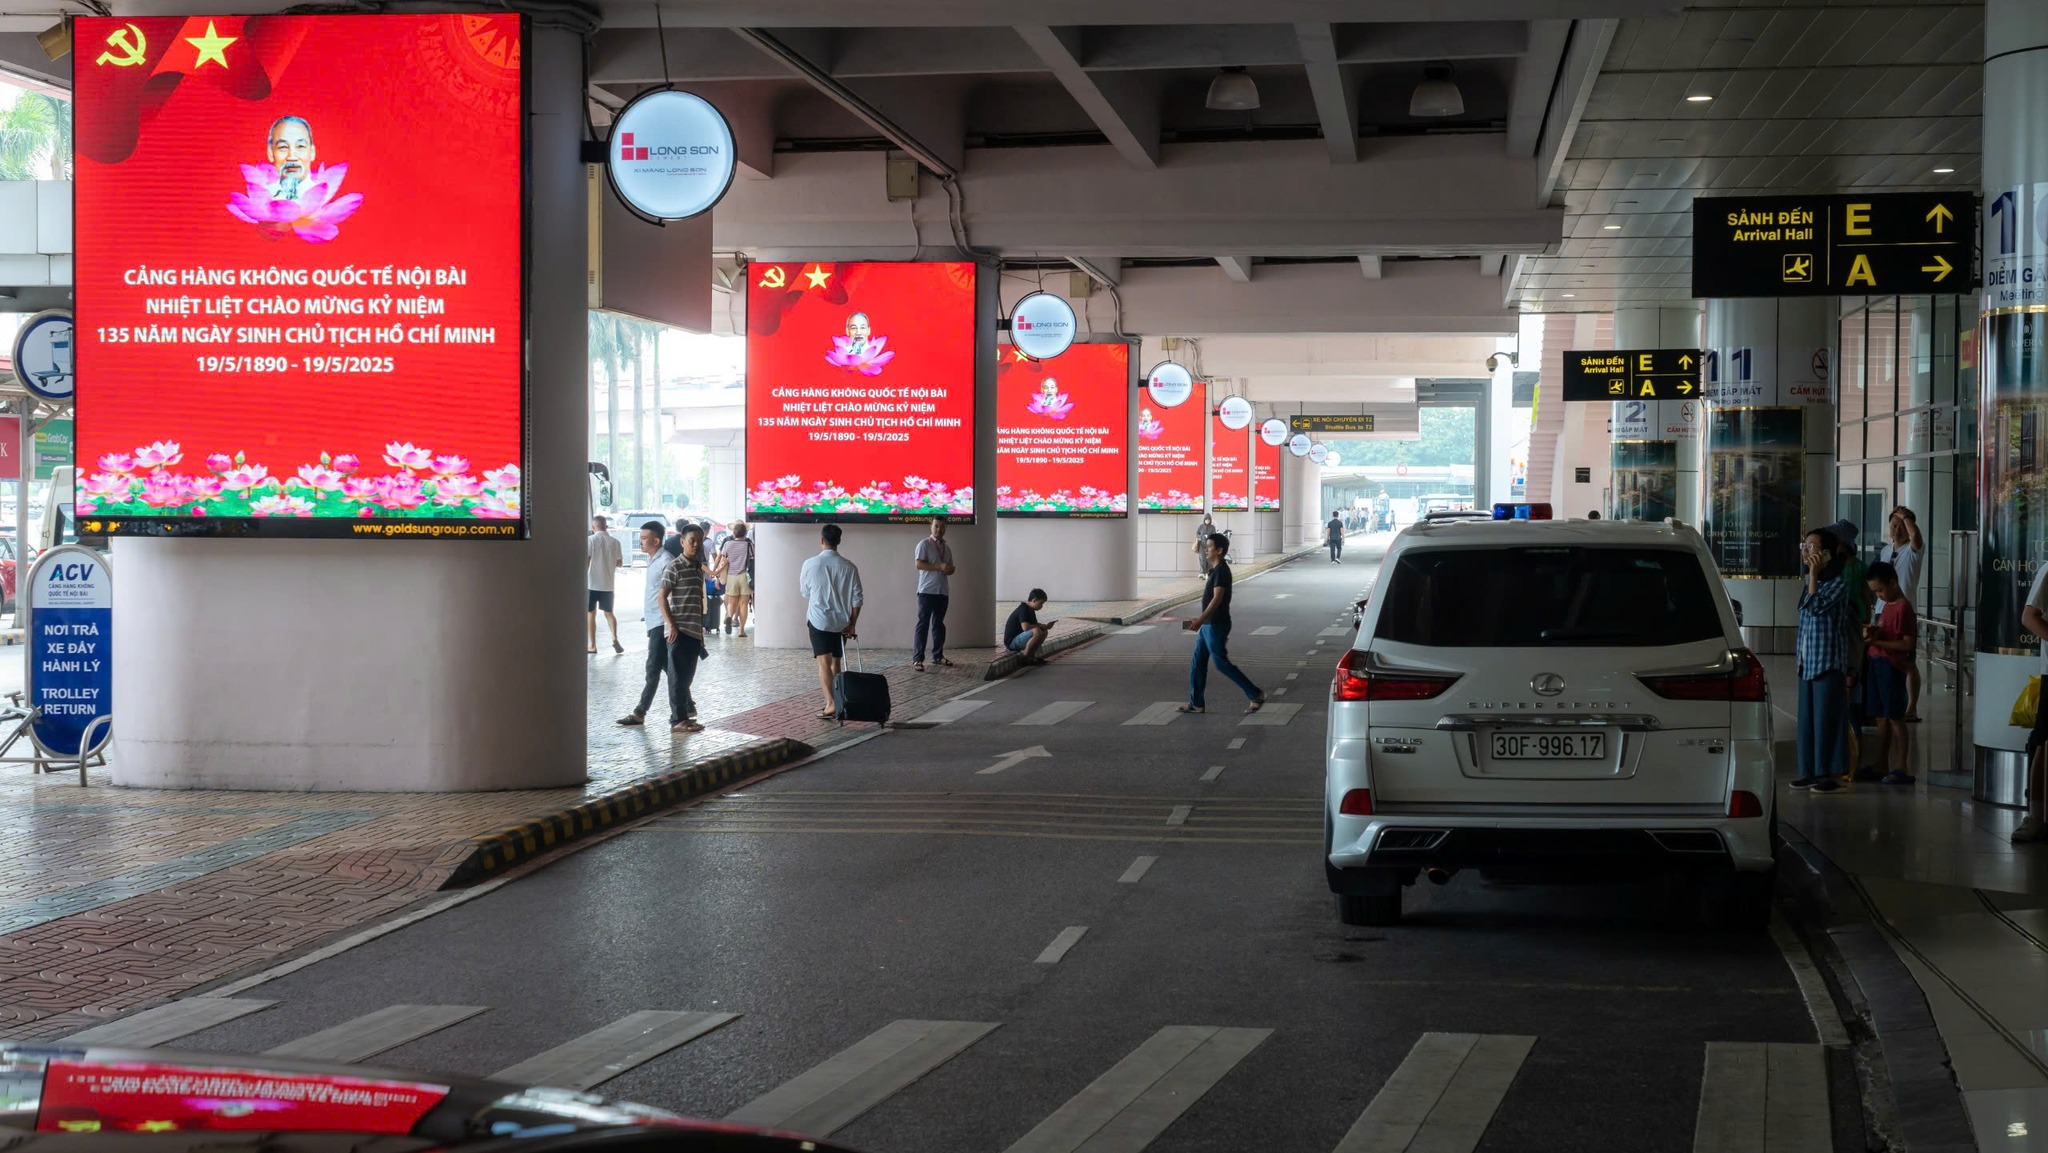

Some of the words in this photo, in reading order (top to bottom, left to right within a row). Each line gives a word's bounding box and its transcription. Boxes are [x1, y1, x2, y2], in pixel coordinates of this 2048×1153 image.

[650, 146, 687, 155] LONG
[690, 146, 719, 154] SON
[1728, 208, 1773, 226] SẢNH
[1778, 207, 1813, 224] ĐẾN
[1846, 204, 1872, 236] E
[1733, 228, 1780, 241] Arrival
[1785, 228, 1813, 240] Hall
[124, 265, 176, 285] CẢNG
[181, 266, 236, 285] HÀNG
[240, 266, 308, 285] KHÔNG
[312, 265, 367, 287] QUỐC
[370, 265, 393, 285] TẾ
[397, 266, 430, 289] NỘI
[436, 266, 466, 285] BÀI
[1846, 254, 1877, 286] A
[1989, 262, 2016, 286] ĐIỂM
[2000, 289, 2044, 302] Meeting
[146, 296, 202, 318] NHIỆT
[206, 296, 243, 318] LIỆT
[247, 296, 300, 314] CHÀO
[304, 295, 364, 314] MỪNG
[368, 294, 392, 314] KỶ
[397, 296, 444, 318] NIỆM
[97, 327, 129, 343] 135
[134, 324, 177, 343] NĂM
[182, 324, 233, 343] NGÀY
[236, 327, 281, 343] SINH
[285, 323, 324, 343] CHỦ
[328, 327, 371, 348] TỊCH
[376, 323, 404, 343] HỒ
[408, 324, 441, 343] CHÍ
[444, 327, 495, 343] MINH
[196, 356, 287, 372] 19/5/1890
[303, 356, 394, 372] 19/5/2025
[1581, 356, 1604, 366] SẢNH
[1606, 356, 1624, 365] ĐẾN
[1640, 354, 1653, 371] E
[1707, 349, 1751, 381] 11
[772, 388, 799, 398] CẢNG
[802, 388, 829, 398] HÀNG
[831, 388, 866, 398] KHÔNG
[868, 388, 896, 398] QUỐC
[898, 388, 909, 398] TẾ
[911, 388, 928, 400] NỘI
[930, 388, 946, 398] BÀI
[1640, 380, 1656, 396] A
[783, 403, 812, 414] NHIỆT
[814, 403, 832, 414] LIỆT
[835, 403, 862, 412] CHÀO
[864, 402, 894, 412] MỪNG
[896, 402, 908, 412] KỶ
[911, 403, 935, 414] NIỆM
[758, 418, 774, 426] 135
[777, 416, 799, 426] NĂM
[802, 416, 827, 426] NGÀY
[830, 418, 852, 426] SINH
[854, 416, 874, 426] CHỦ
[876, 418, 898, 428] TỊCH
[900, 416, 914, 426] HỒ
[916, 417, 933, 426] CHÍ
[934, 418, 961, 426] MINH
[809, 432, 855, 441] 19/5/1890
[863, 432, 909, 441] 19/5/2025
[1085, 428, 1096, 436] NỘI
[353, 524, 514, 536] www.goldsungroup.com.vn
[48, 564, 94, 581] ACV
[1993, 557, 2014, 572] CĂN
[2018, 557, 2038, 574] HỘ
[45, 625, 68, 636] NƠI
[72, 623, 98, 636] TRẢ
[47, 643, 65, 654] XE
[42, 659, 80, 672] HÀNH
[84, 658, 100, 672] LÝ
[42, 688, 99, 699] TROLLEY
[44, 704, 96, 714] RETURN
[1496, 736, 1600, 756] 30F-996.17
